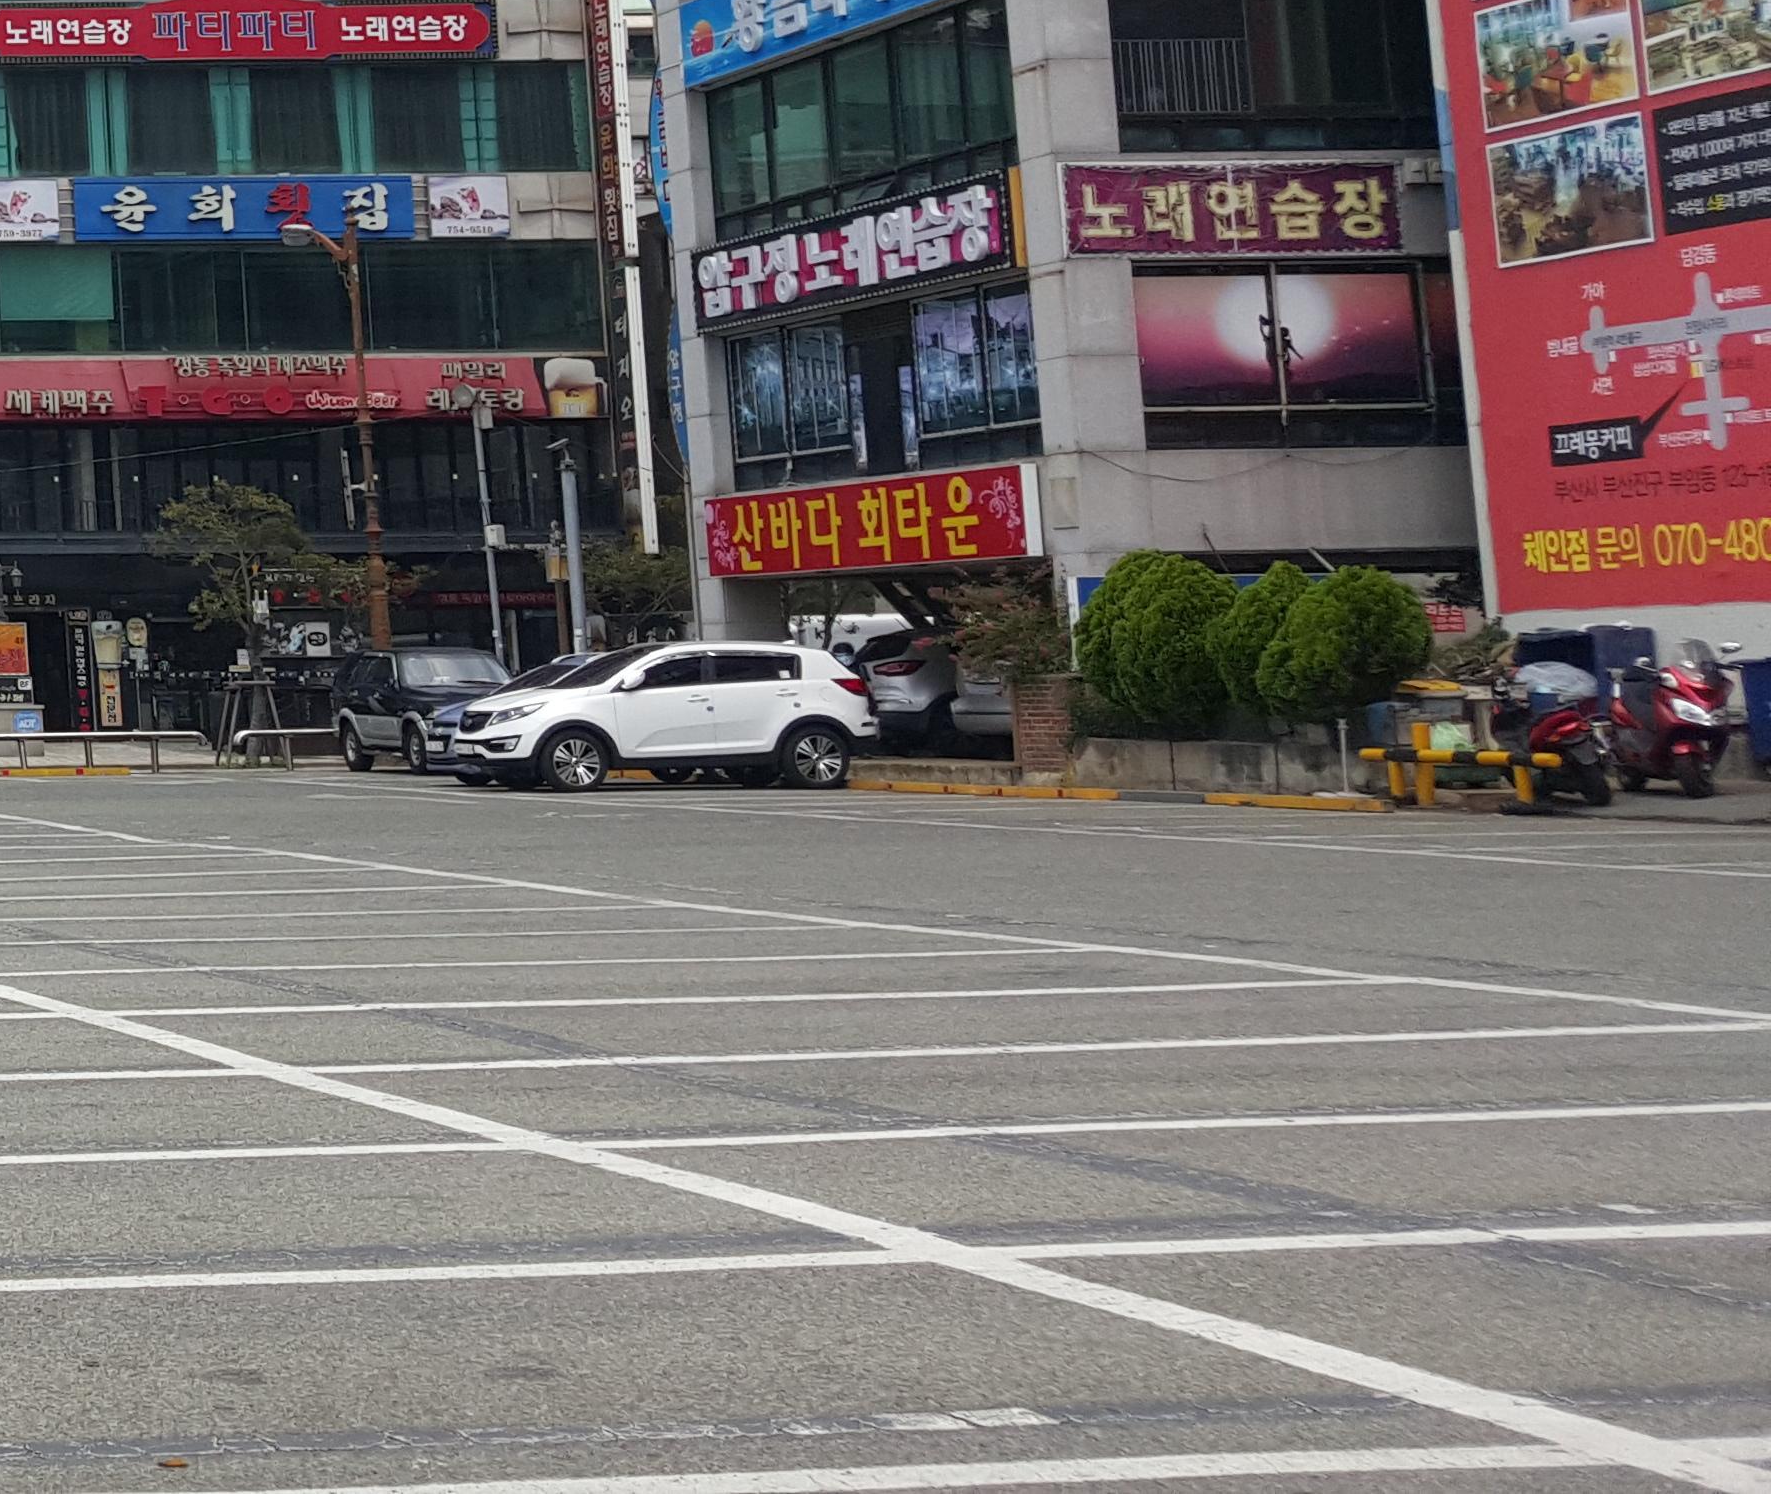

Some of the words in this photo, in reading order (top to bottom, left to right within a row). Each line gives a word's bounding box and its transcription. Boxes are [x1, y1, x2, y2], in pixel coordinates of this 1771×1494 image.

[4, 19, 131, 44] 노래연습장
[152, 9, 317, 50] 파티파티
[340, 16, 468, 42] 노래연습장
[1081, 178, 1387, 242] 노래연습장
[4, 388, 114, 414] 세계맥주
[731, 491, 843, 571] 산바다
[858, 476, 980, 564] 회타운
[1523, 529, 1592, 573] 체인점
[1596, 524, 1645, 569] 문의
